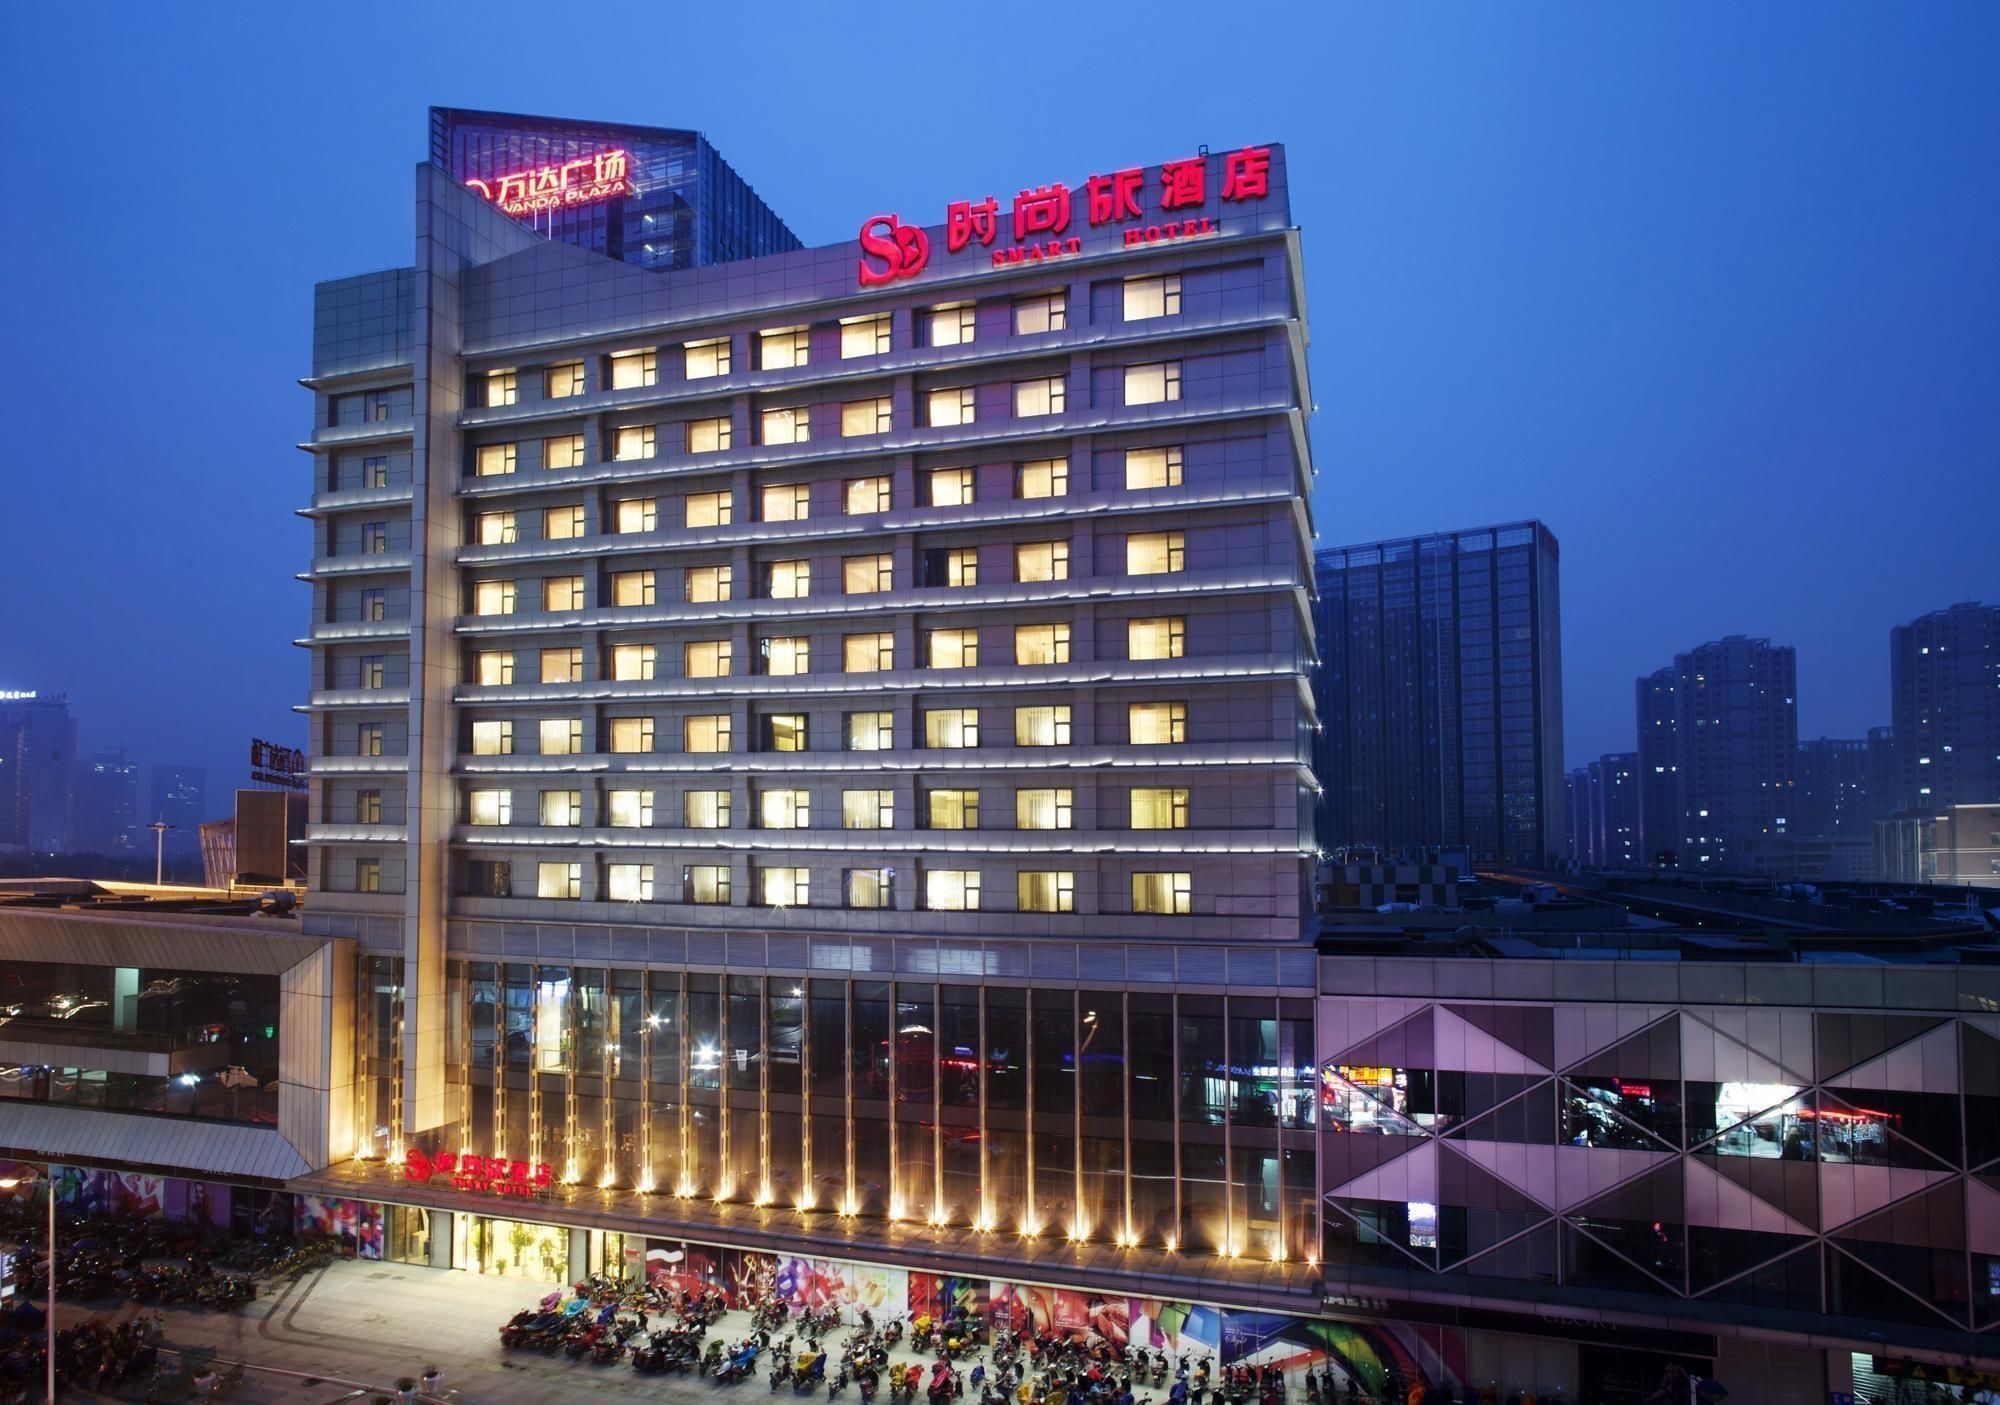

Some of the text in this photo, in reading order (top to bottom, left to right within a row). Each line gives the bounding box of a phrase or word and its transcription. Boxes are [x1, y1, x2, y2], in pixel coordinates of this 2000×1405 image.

[496, 149, 626, 204] 万达广场
[565, 180, 626, 203] PLAZA
[992, 217, 1216, 268] SMART HOTEL
